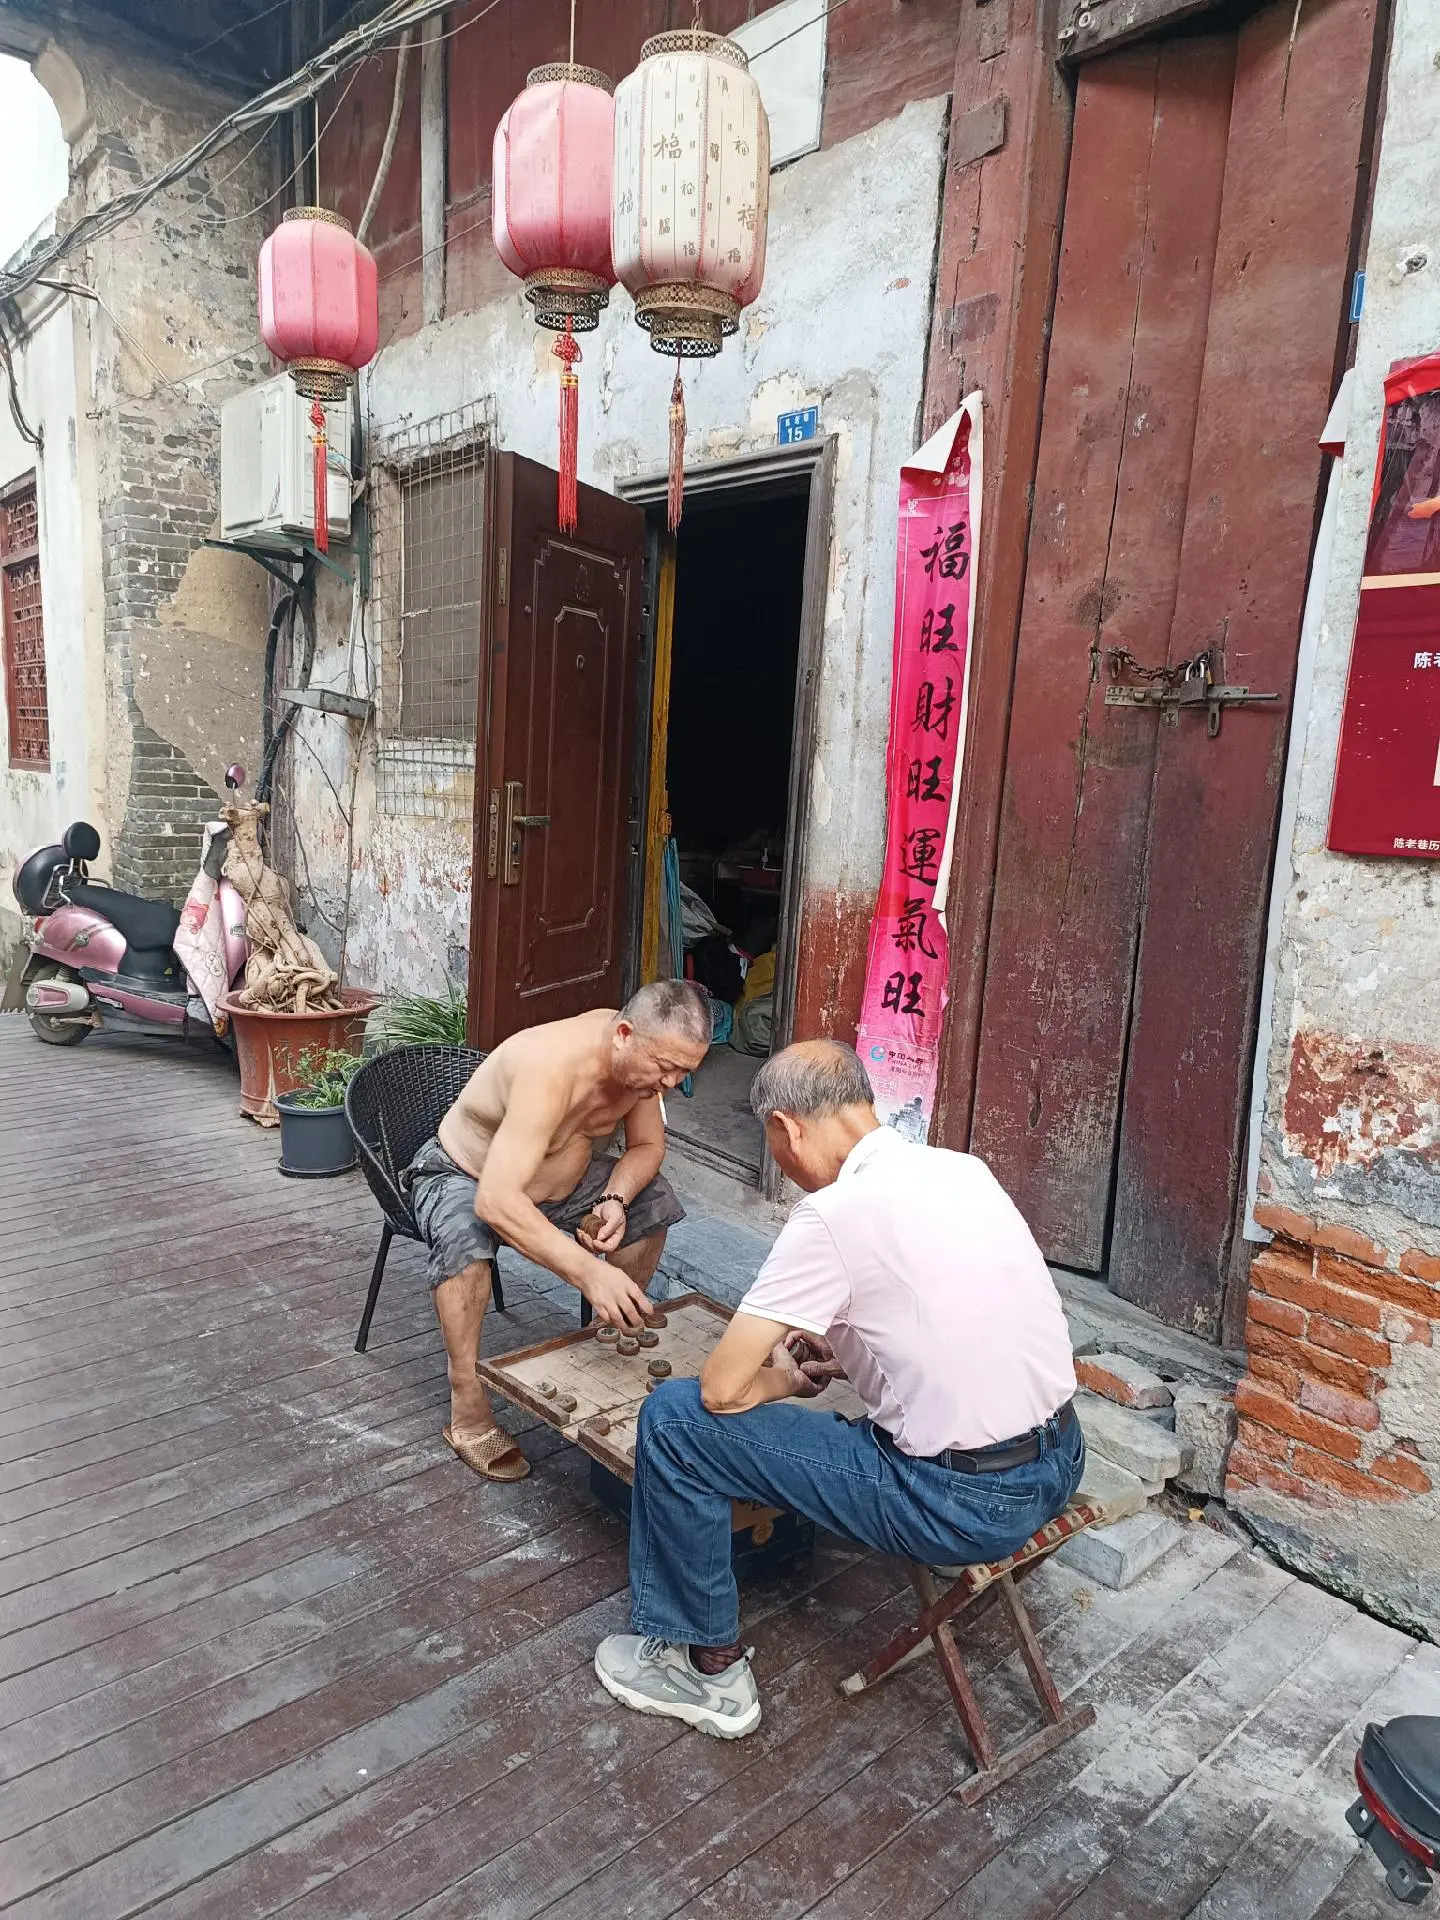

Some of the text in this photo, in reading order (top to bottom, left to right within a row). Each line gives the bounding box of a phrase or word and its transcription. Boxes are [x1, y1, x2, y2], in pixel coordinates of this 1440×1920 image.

[653, 132, 682, 160] 福
[737, 203, 756, 231] 福
[787, 427, 803, 443] 15
